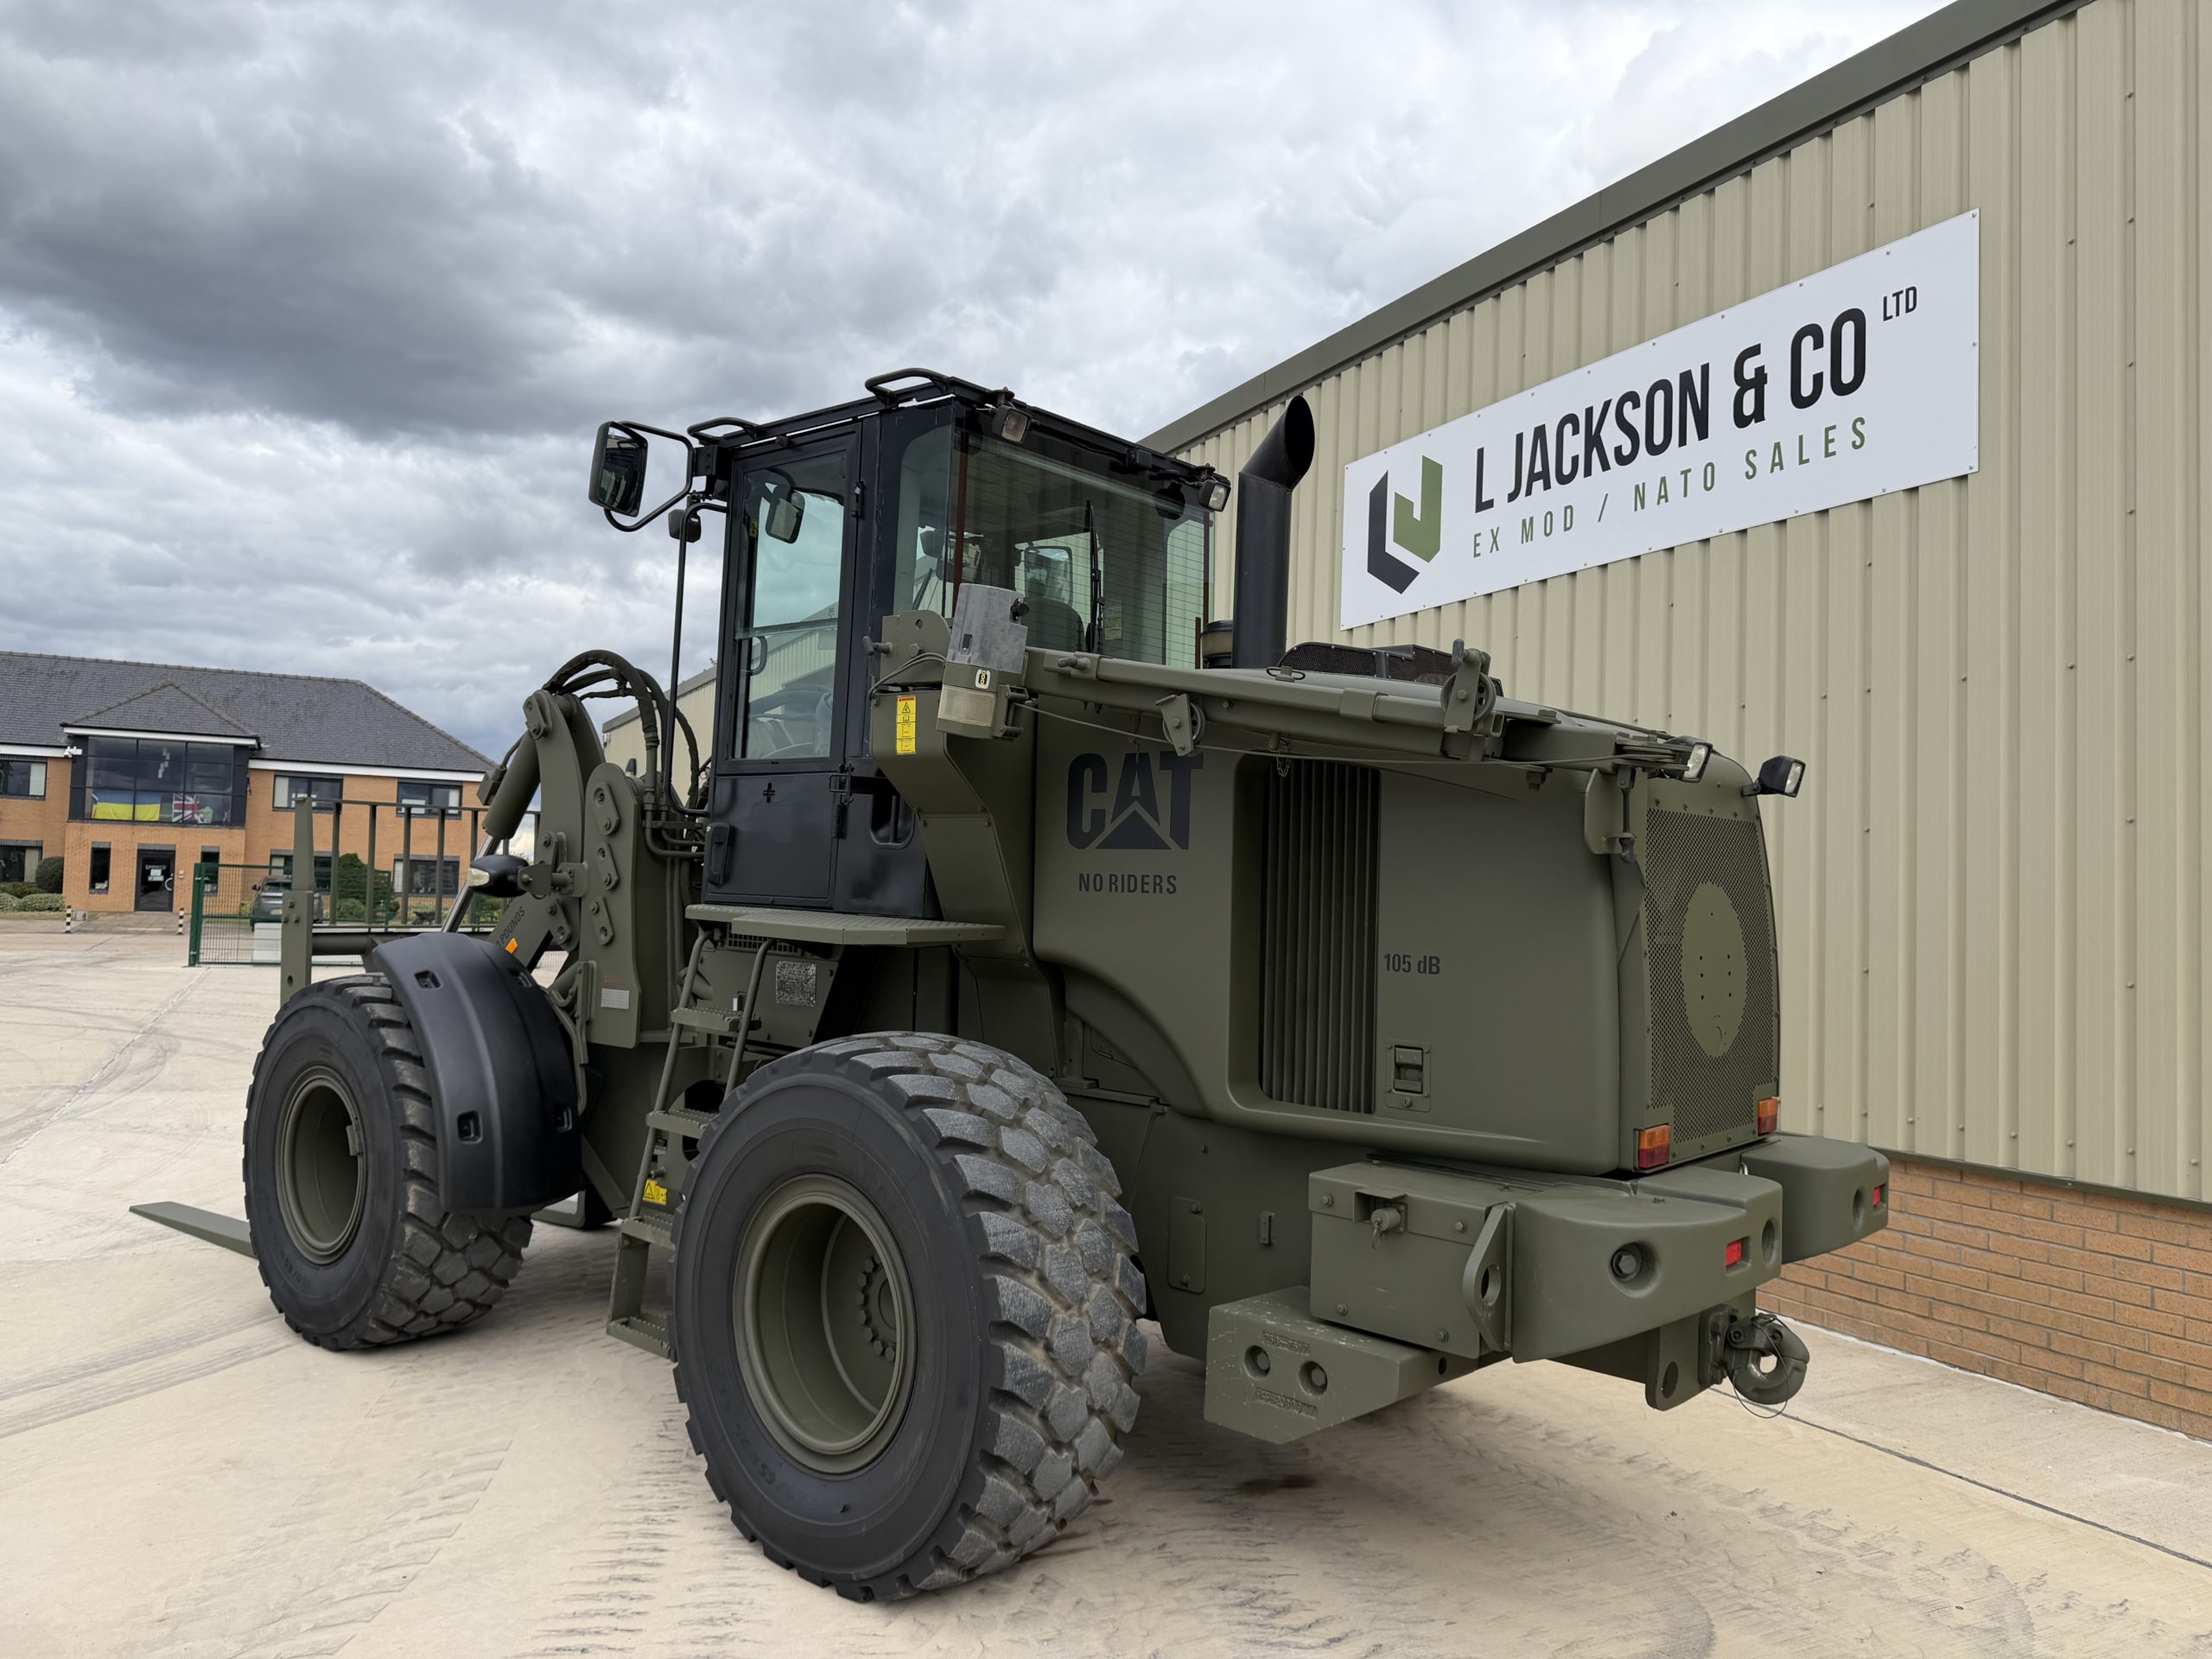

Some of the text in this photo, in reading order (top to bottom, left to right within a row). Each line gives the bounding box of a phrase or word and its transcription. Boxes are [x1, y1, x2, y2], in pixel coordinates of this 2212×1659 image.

[1475, 286, 1917, 514] L JACKSON & CO LTD
[1472, 526, 1501, 558] EX
[1521, 505, 1574, 544] MOD
[1634, 462, 1716, 512] NATO
[1745, 416, 1866, 480] SALES
[1066, 751, 1204, 850] CAT
[1078, 872, 1177, 894] NO RIDERS
[500, 906, 525, 944] POUNDS
[1384, 953, 1440, 975] 105 dB
